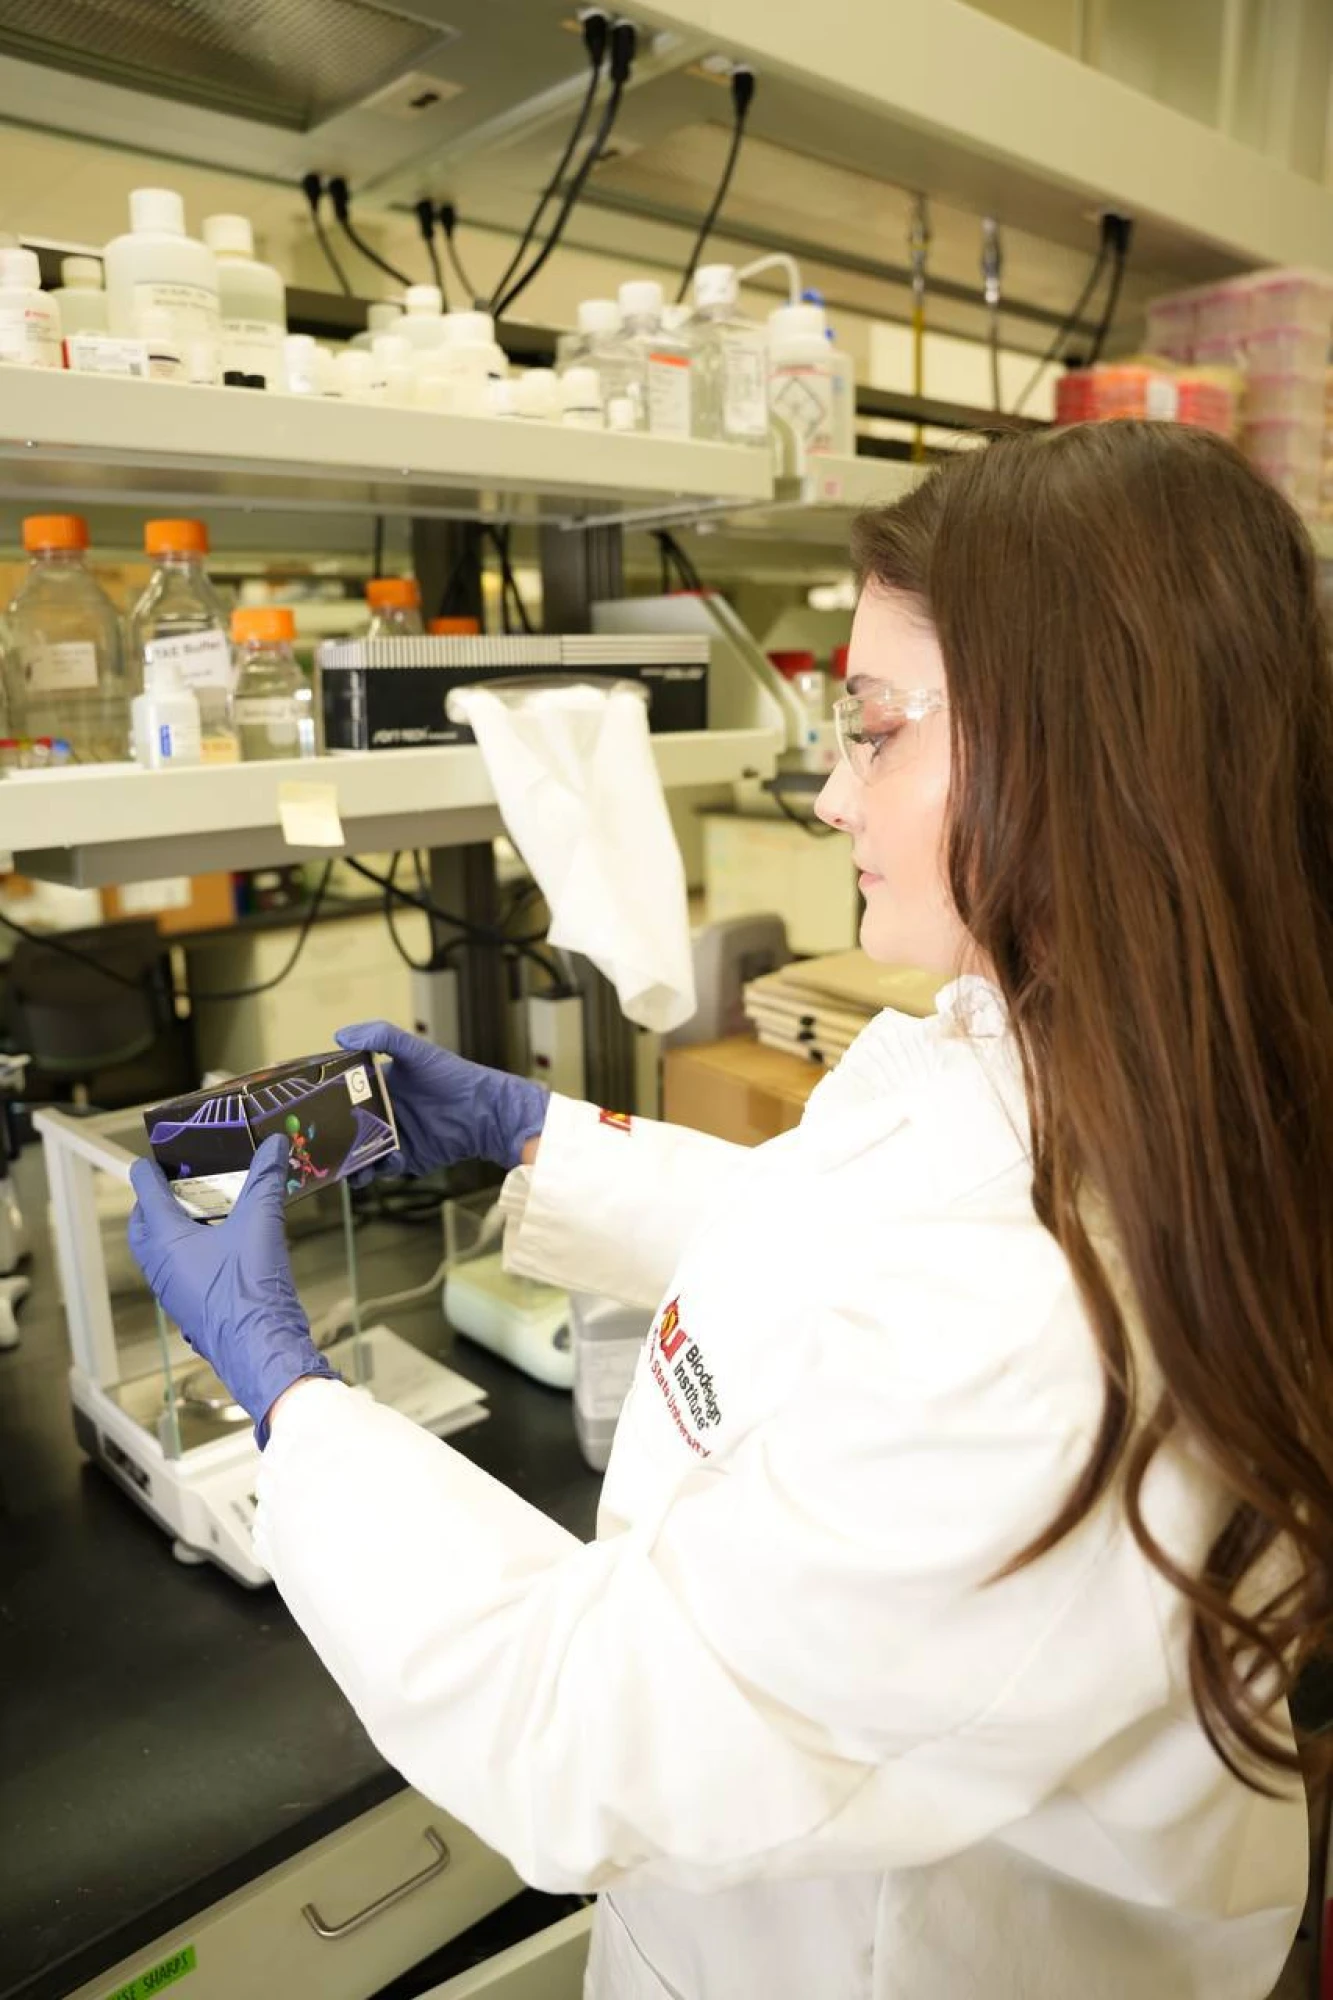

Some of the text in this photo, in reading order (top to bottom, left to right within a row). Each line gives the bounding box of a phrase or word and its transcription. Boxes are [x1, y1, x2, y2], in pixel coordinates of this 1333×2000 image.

[350, 1071, 365, 1093] G
[651, 1360, 711, 1458] State University
[674, 1360, 706, 1430] Institute
[686, 1344, 721, 1425] Biodesign
